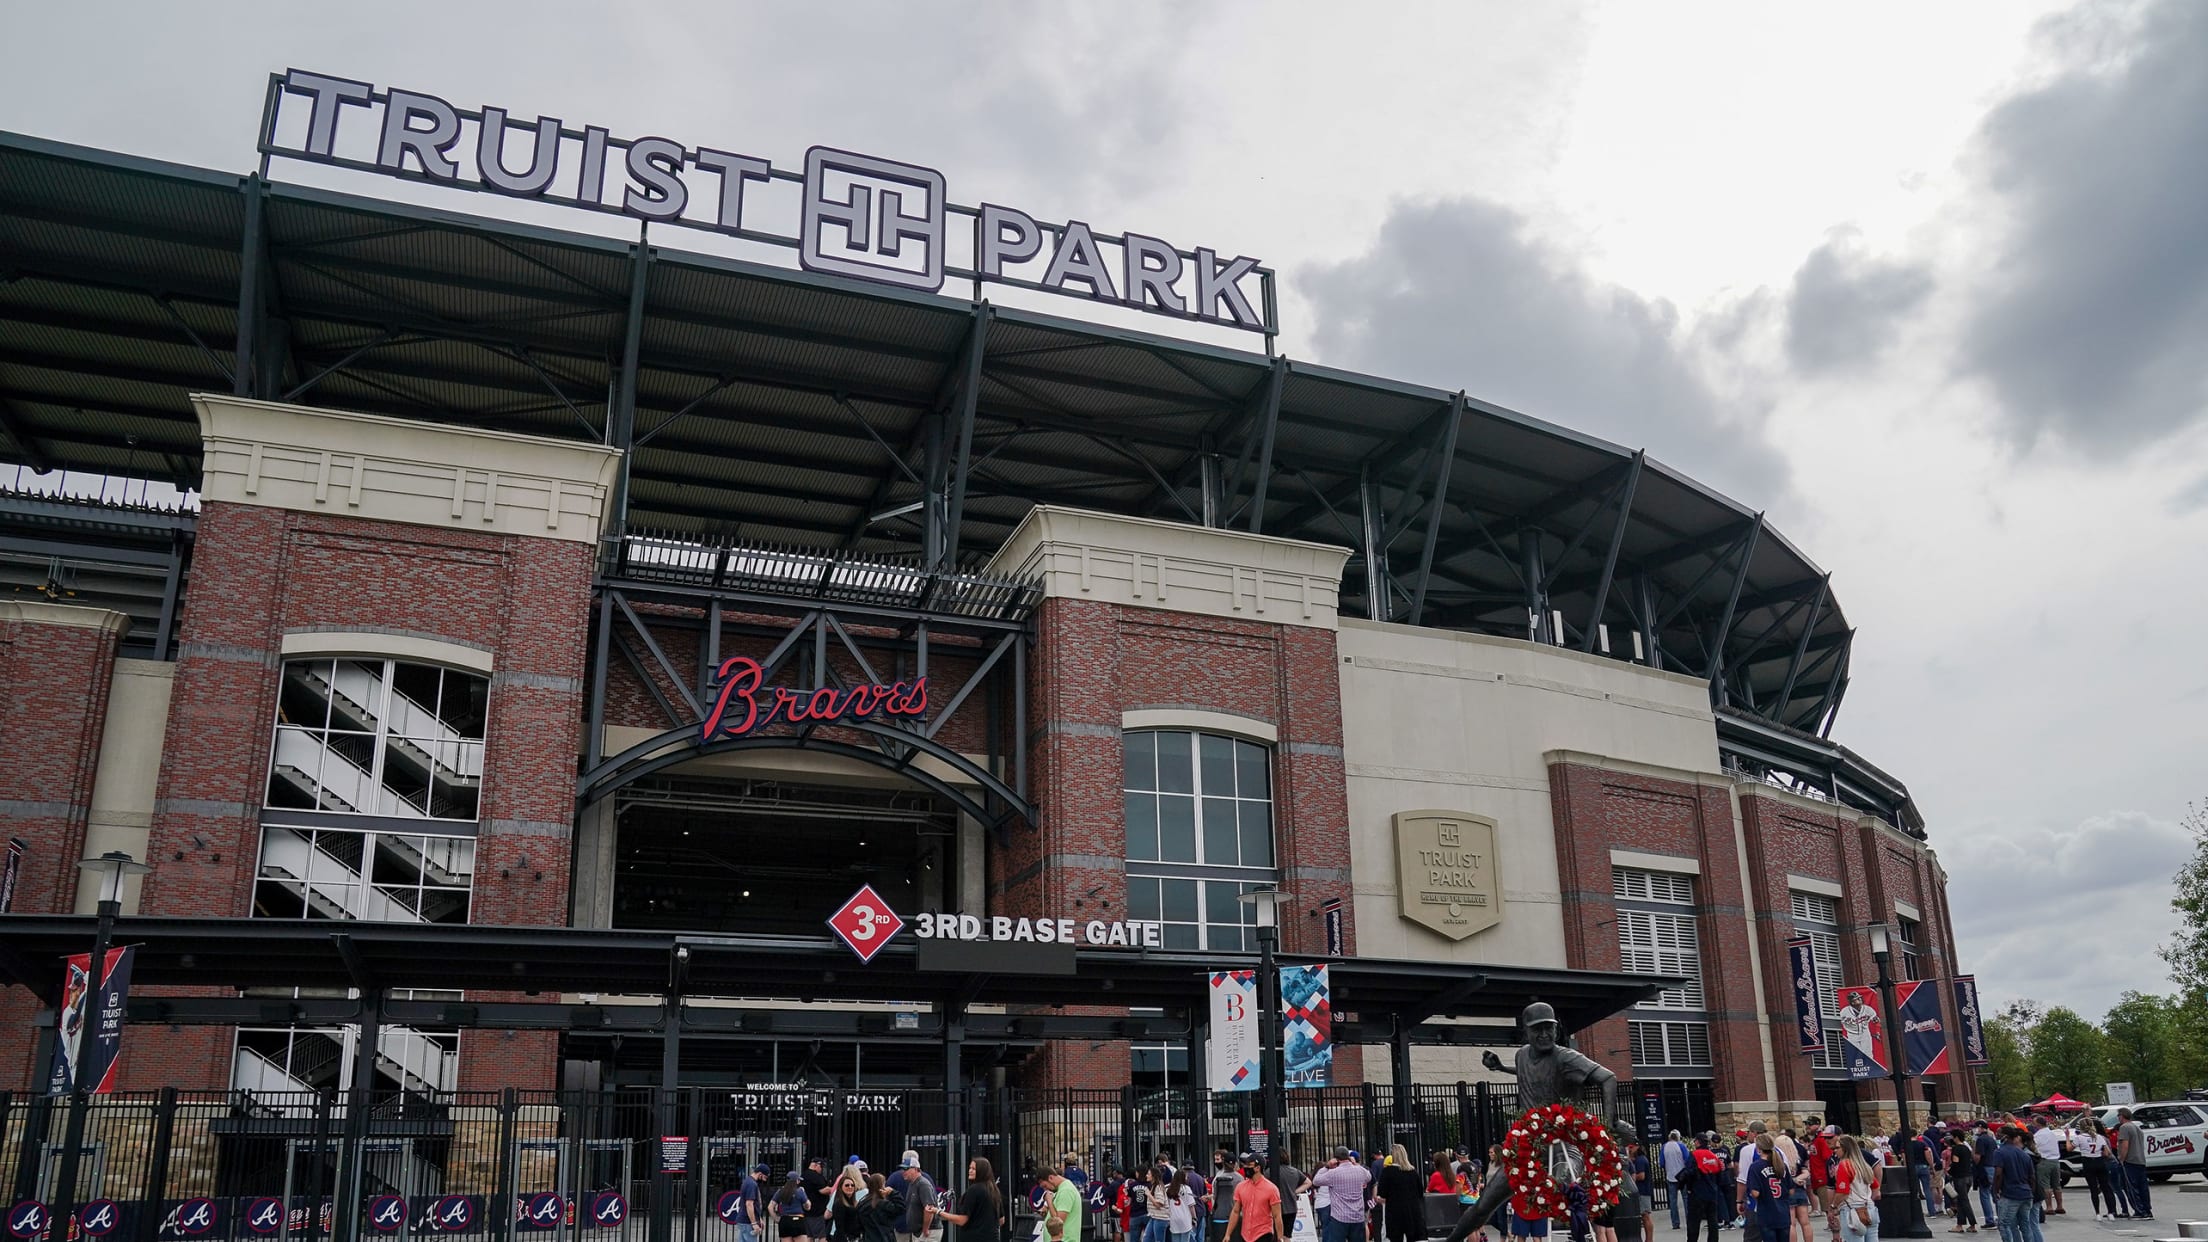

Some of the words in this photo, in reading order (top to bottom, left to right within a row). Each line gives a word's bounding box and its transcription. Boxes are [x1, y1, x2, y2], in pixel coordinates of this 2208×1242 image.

[287, 68, 772, 233] TRUIST
[980, 202, 1266, 333] PARK
[702, 656, 928, 742] Braves
[1419, 850, 1481, 869] TRUIST
[1429, 870, 1476, 888] PARK
[914, 913, 981, 940] 3RD
[992, 916, 1075, 944] BASE
[1086, 920, 1161, 947] GATE
[1290, 1069, 1325, 1083] LIVE
[746, 1083, 787, 1091] WELCOME
[788, 1083, 799, 1091] TO
[2088, 1143, 2097, 1155] 7
[2146, 1133, 2184, 1155] Braves
[1135, 1189, 1145, 1203] 5
[1769, 1178, 1781, 1198] 5
